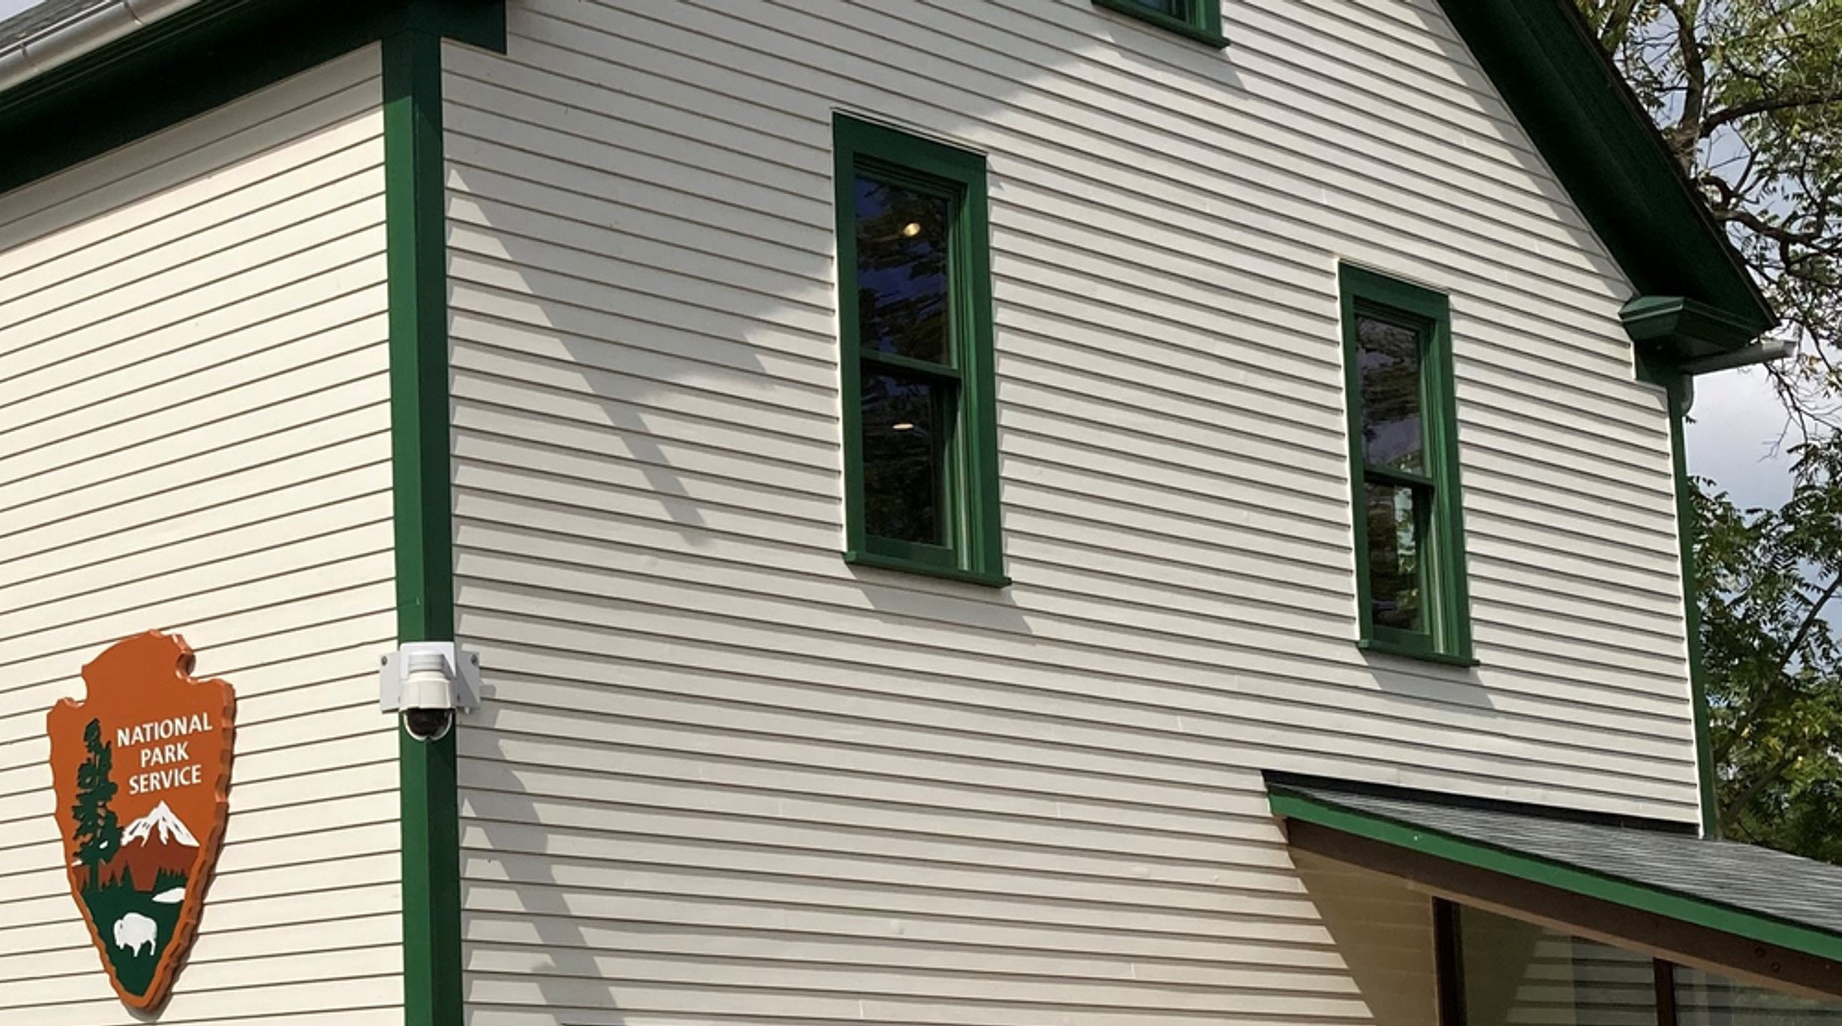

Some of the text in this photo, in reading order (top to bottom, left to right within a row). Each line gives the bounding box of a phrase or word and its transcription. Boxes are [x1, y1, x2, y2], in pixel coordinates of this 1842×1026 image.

[116, 711, 213, 748] NATIONAL
[140, 741, 190, 768] PARK
[128, 764, 202, 795] SERVICE
